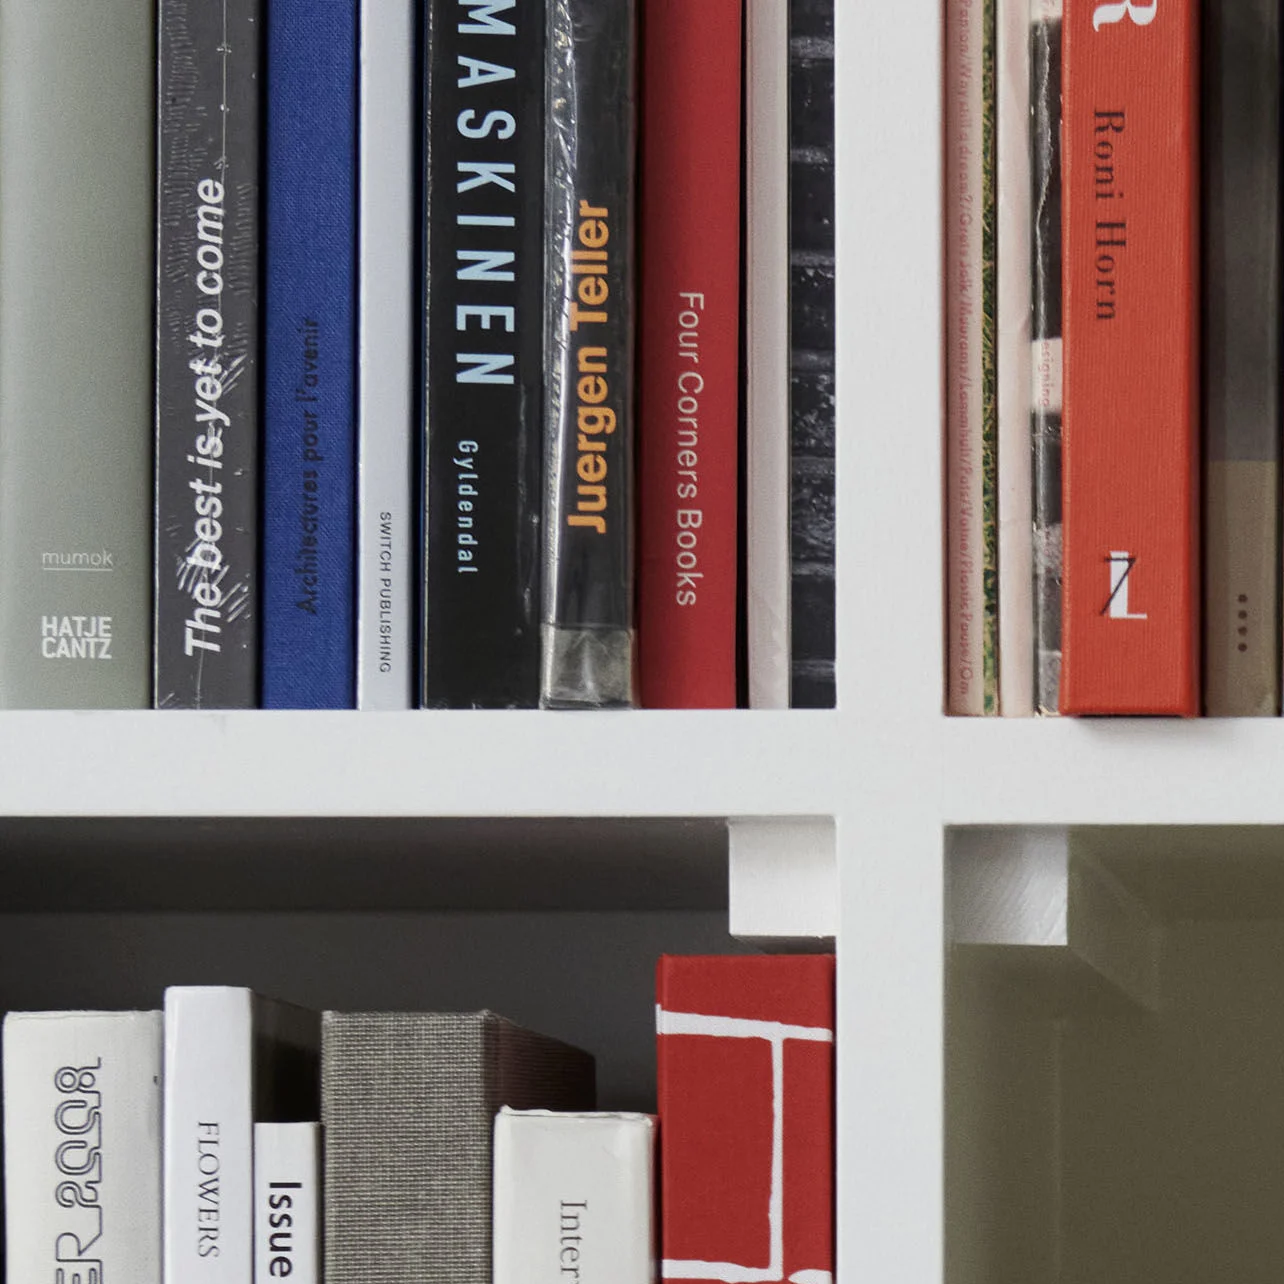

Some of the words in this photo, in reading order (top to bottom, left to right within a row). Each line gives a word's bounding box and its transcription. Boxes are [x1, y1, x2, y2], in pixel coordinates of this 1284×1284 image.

[1093, 109, 1125, 199] Roni
[198, 177, 227, 297] come
[566, 198, 609, 331] Teller
[1095, 221, 1127, 320] Horn
[188, 309, 224, 347] to
[678, 292, 705, 364] Four
[191, 359, 233, 427] yet
[566, 346, 616, 535] Juergen
[676, 371, 705, 499] Corners
[187, 436, 223, 470] is
[187, 481, 224, 571] best
[379, 511, 392, 572] SWITCH
[452, 440, 479, 573] Gyldendal
[675, 509, 704, 606] Books
[41, 615, 111, 639] HATJE
[41, 635, 112, 660] CANTZ
[185, 581, 222, 656] The
[379, 578, 392, 673] PUBLISHING
[54, 1059, 103, 1211] 2008
[198, 1122, 219, 1258] FLOWERS
[268, 1182, 303, 1278] Issue
